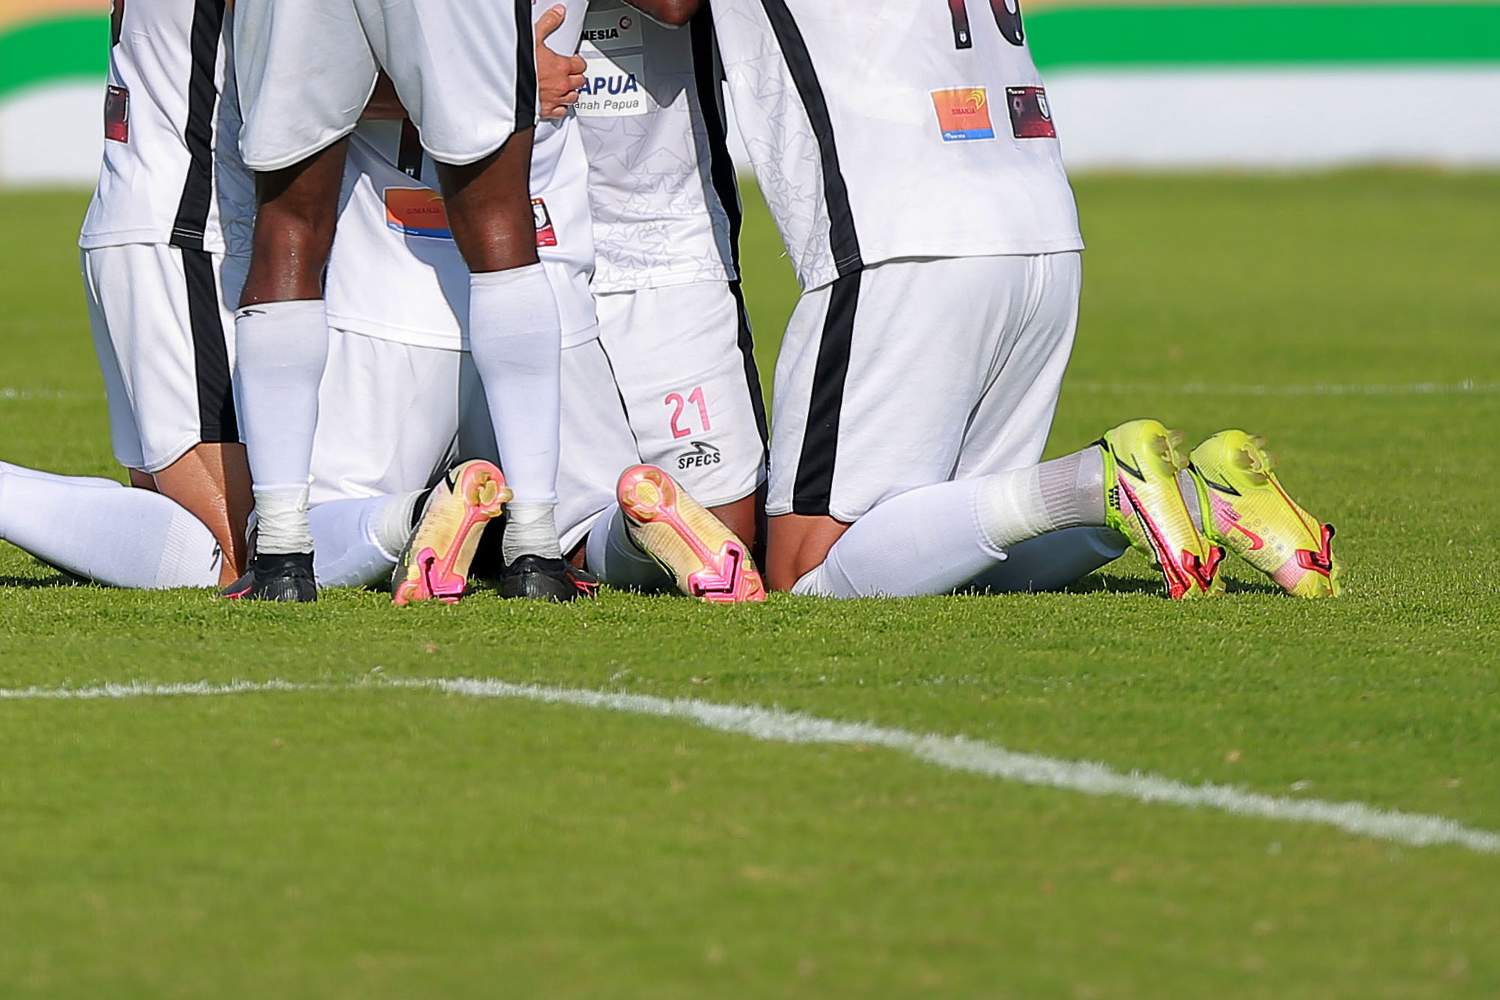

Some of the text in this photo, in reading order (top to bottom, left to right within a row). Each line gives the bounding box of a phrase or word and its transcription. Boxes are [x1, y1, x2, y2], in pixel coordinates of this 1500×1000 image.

[603, 99, 639, 112] Papua
[665, 386, 711, 439] 21
[678, 452, 721, 469] SPECS
